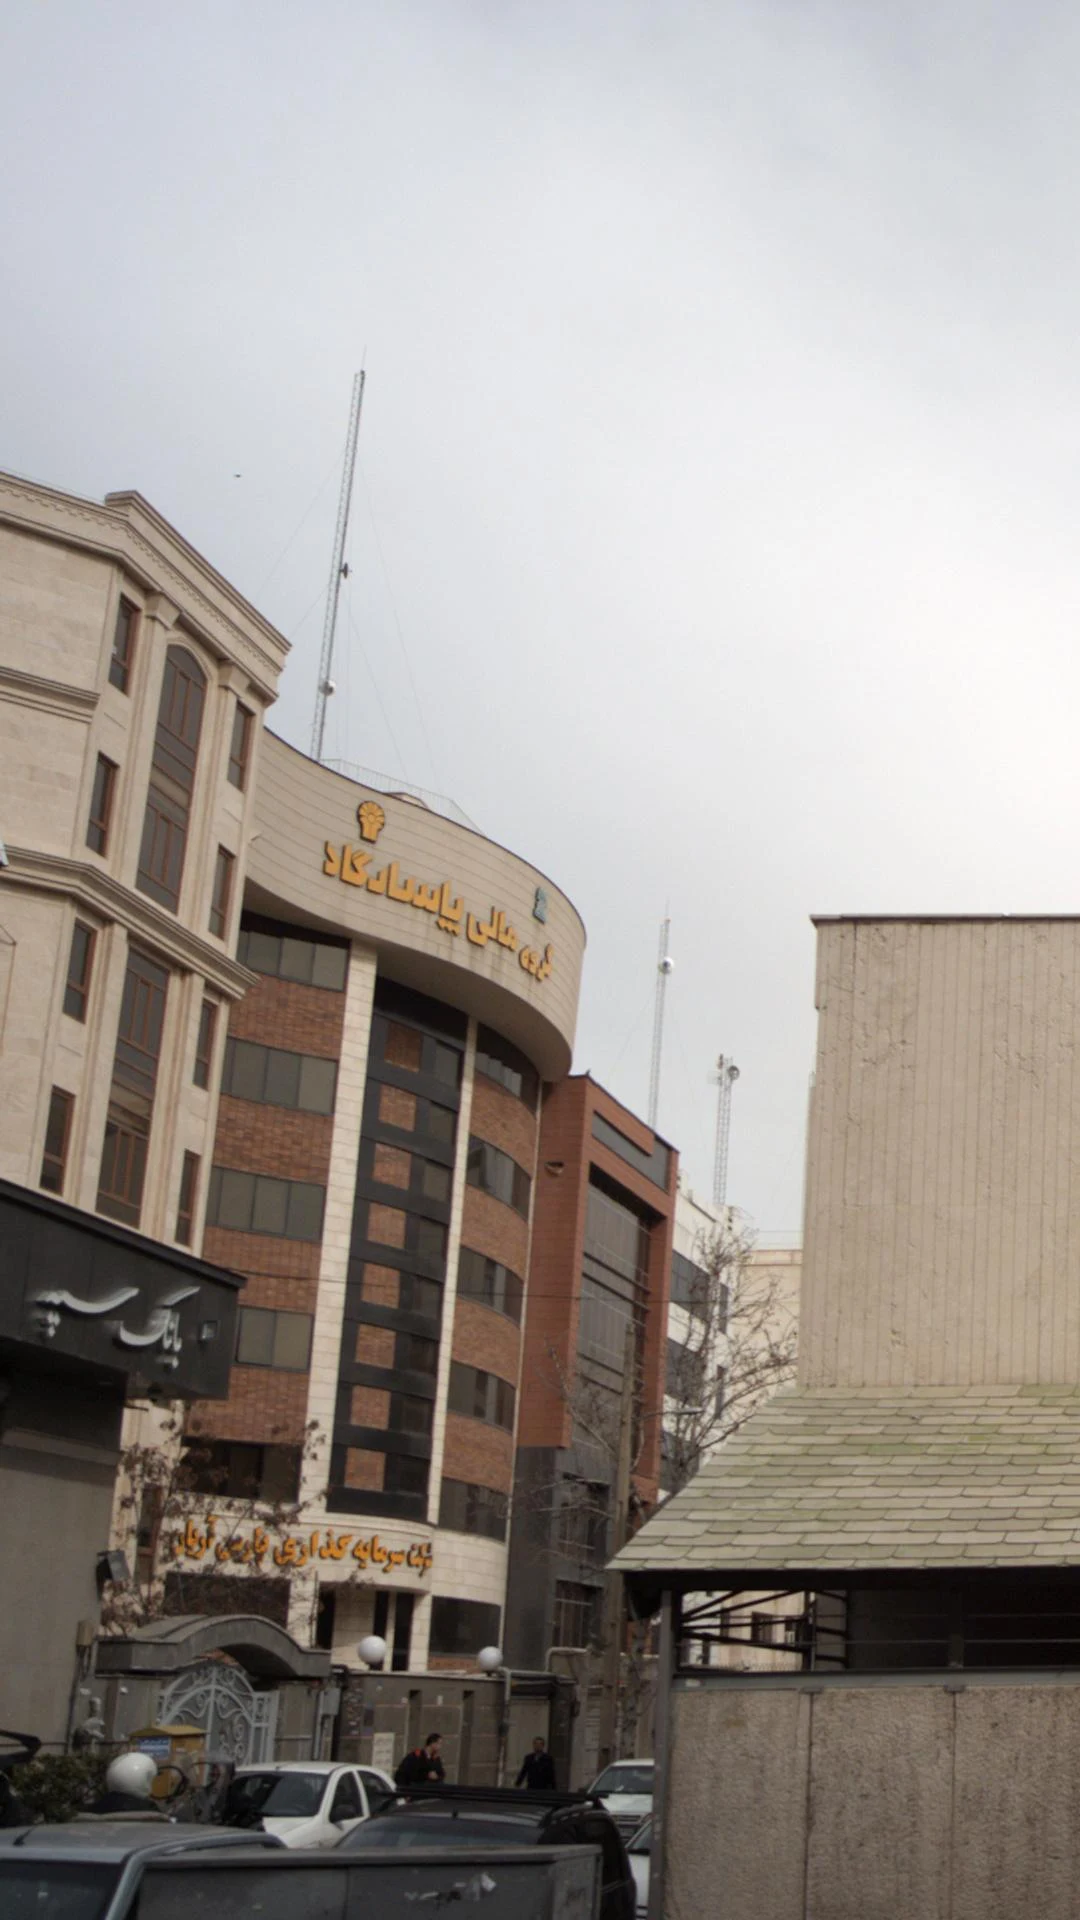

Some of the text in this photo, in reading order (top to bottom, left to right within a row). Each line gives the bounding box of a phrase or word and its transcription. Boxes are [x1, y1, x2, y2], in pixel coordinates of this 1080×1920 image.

[323, 841, 554, 981] گروه مالی پاسارگاد
[117, 1286, 201, 1369] بانک
[352, 1535, 406, 1573] سرمایه
